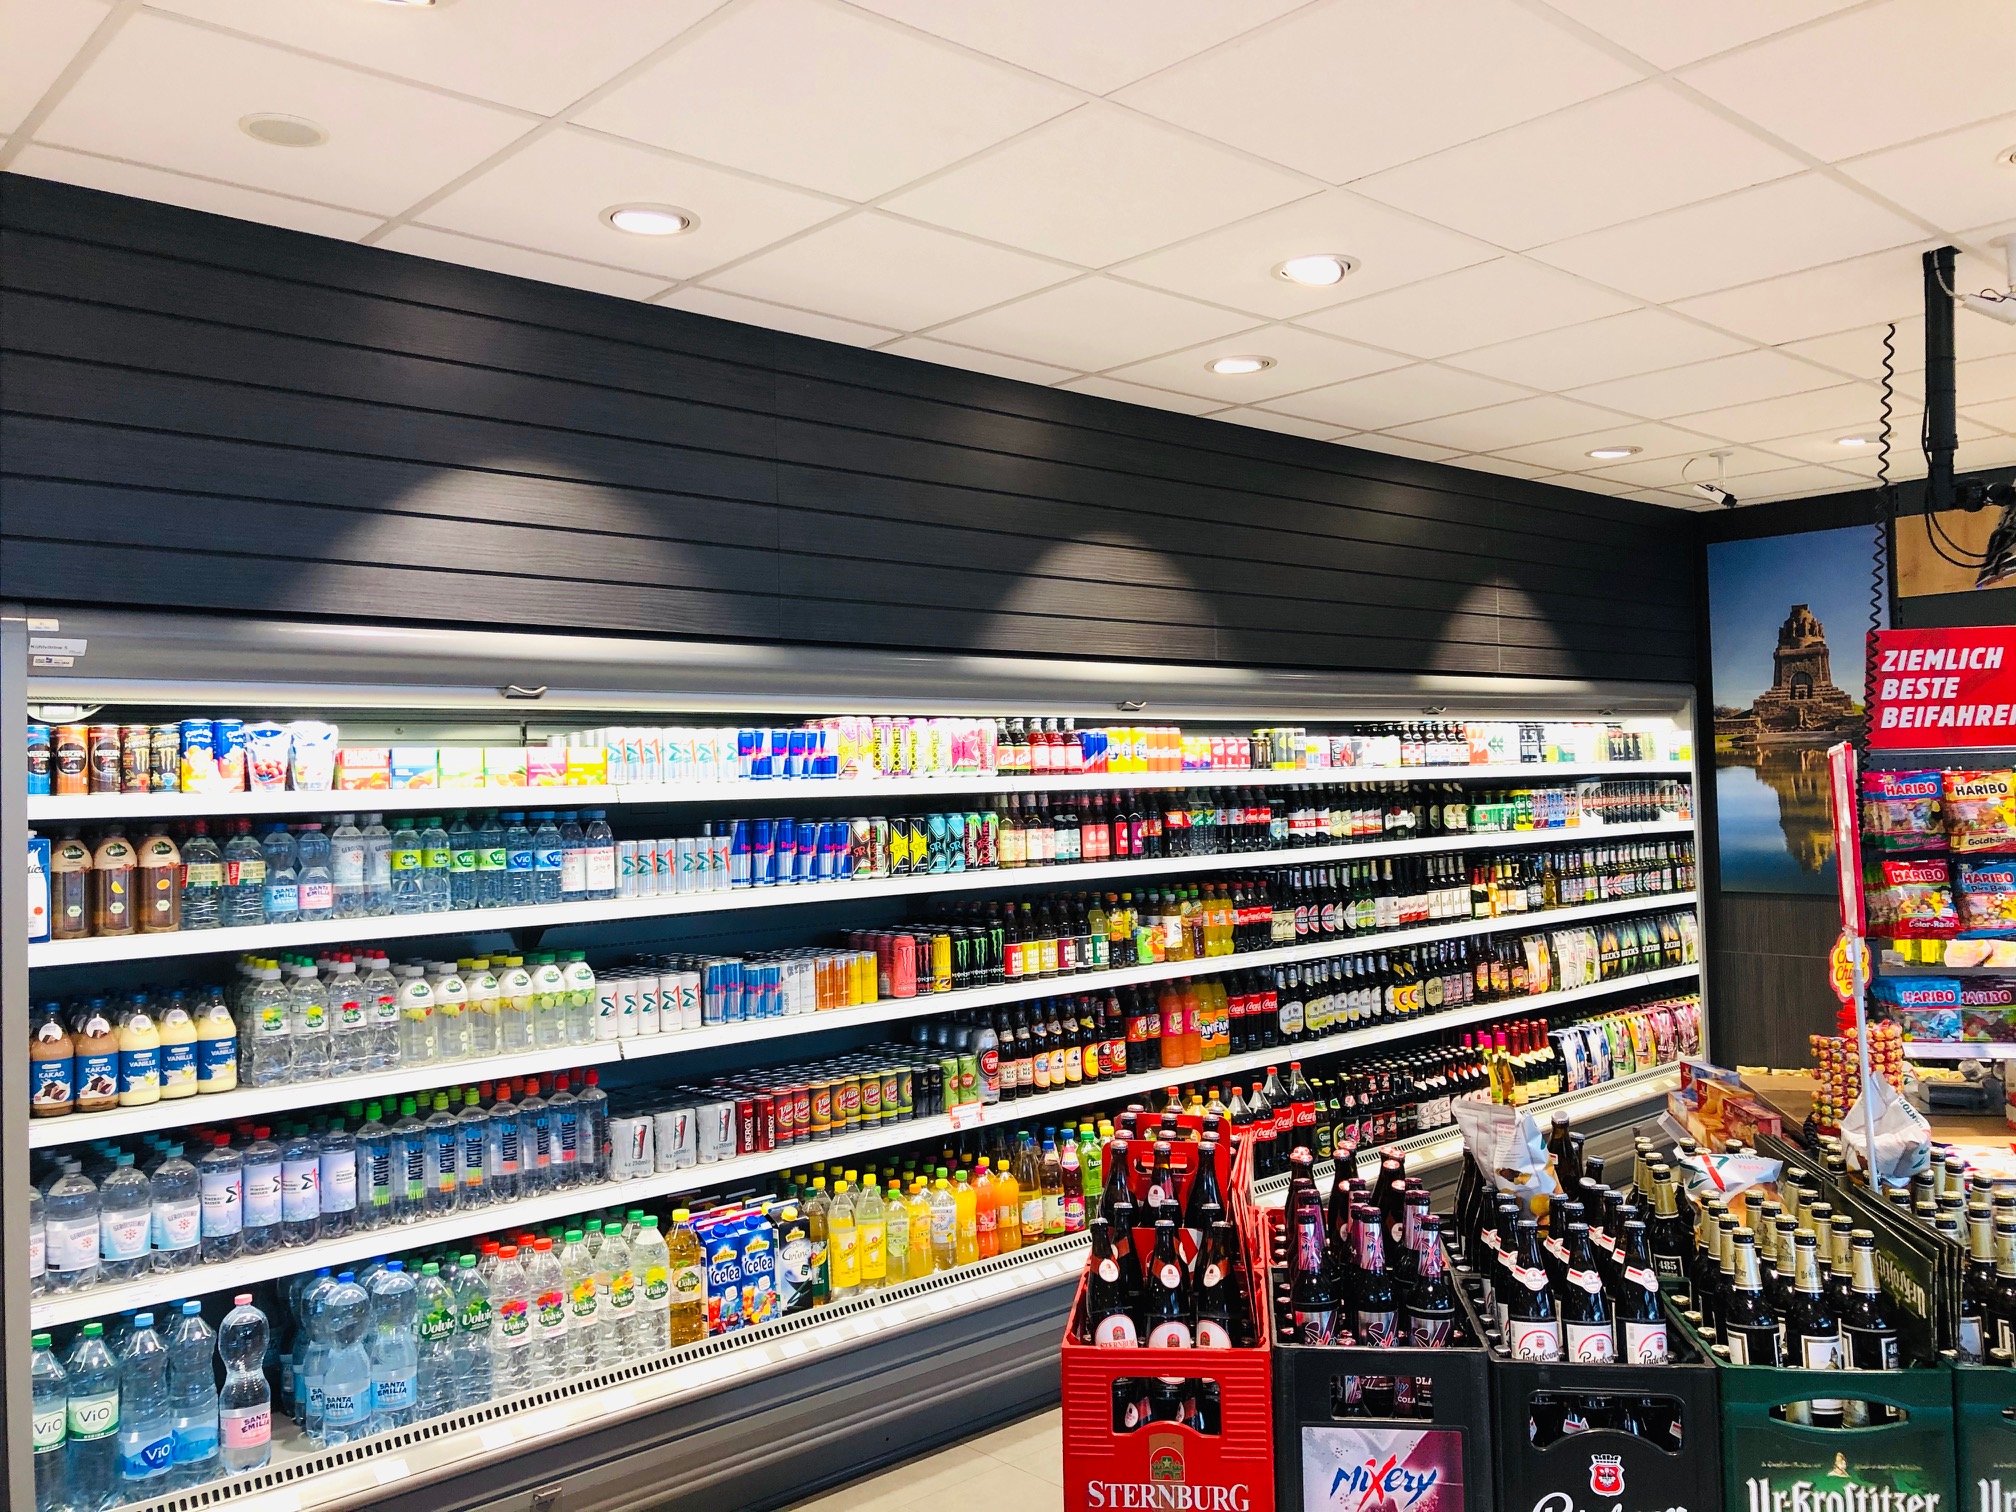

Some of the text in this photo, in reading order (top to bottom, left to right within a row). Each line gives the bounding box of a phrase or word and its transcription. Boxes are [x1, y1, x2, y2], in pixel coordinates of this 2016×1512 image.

[1881, 647, 2004, 672] ZIEMLICH
[1881, 677, 1960, 700] BESTE
[1885, 783, 1937, 796] HARIBO
[1955, 782, 2008, 796] HARIBO
[593, 854, 613, 863] evian
[1892, 869, 1945, 883] HARIBO
[1962, 872, 2014, 884] HARIBO
[1902, 990, 1955, 1004] HARIBO
[167, 1053, 193, 1062] VANILLE
[210, 1048, 234, 1056] VANILLE
[85, 1065, 111, 1073] KAKAO
[129, 1059, 156, 1067] VANILLE
[39, 1071, 64, 1079] KAKAO
[562, 1121, 576, 1150] ACTIVE
[503, 1131, 517, 1161] ACTIVE
[440, 1142, 455, 1173] ACTIVE
[467, 1137, 482, 1168] ACTIVE
[374, 1154, 389, 1186] ACTIVE
[408, 1149, 423, 1180] ACTIVE
[1658, 1259, 1677, 1271] 485
[462, 1310, 493, 1326] Volvic
[539, 1311, 564, 1322] Volvic
[422, 1319, 455, 1335] Volvic
[503, 1320, 529, 1331] Volvic
[379, 1381, 405, 1389] SANTA
[1416, 1376, 1433, 1385] OLA
[377, 1387, 407, 1396] EMILIA
[325, 1402, 354, 1410] EMILIA
[326, 1396, 351, 1404] SANTA
[1397, 1396, 1416, 1404] COLA
[1087, 1480, 1250, 1511] STERNBURG
